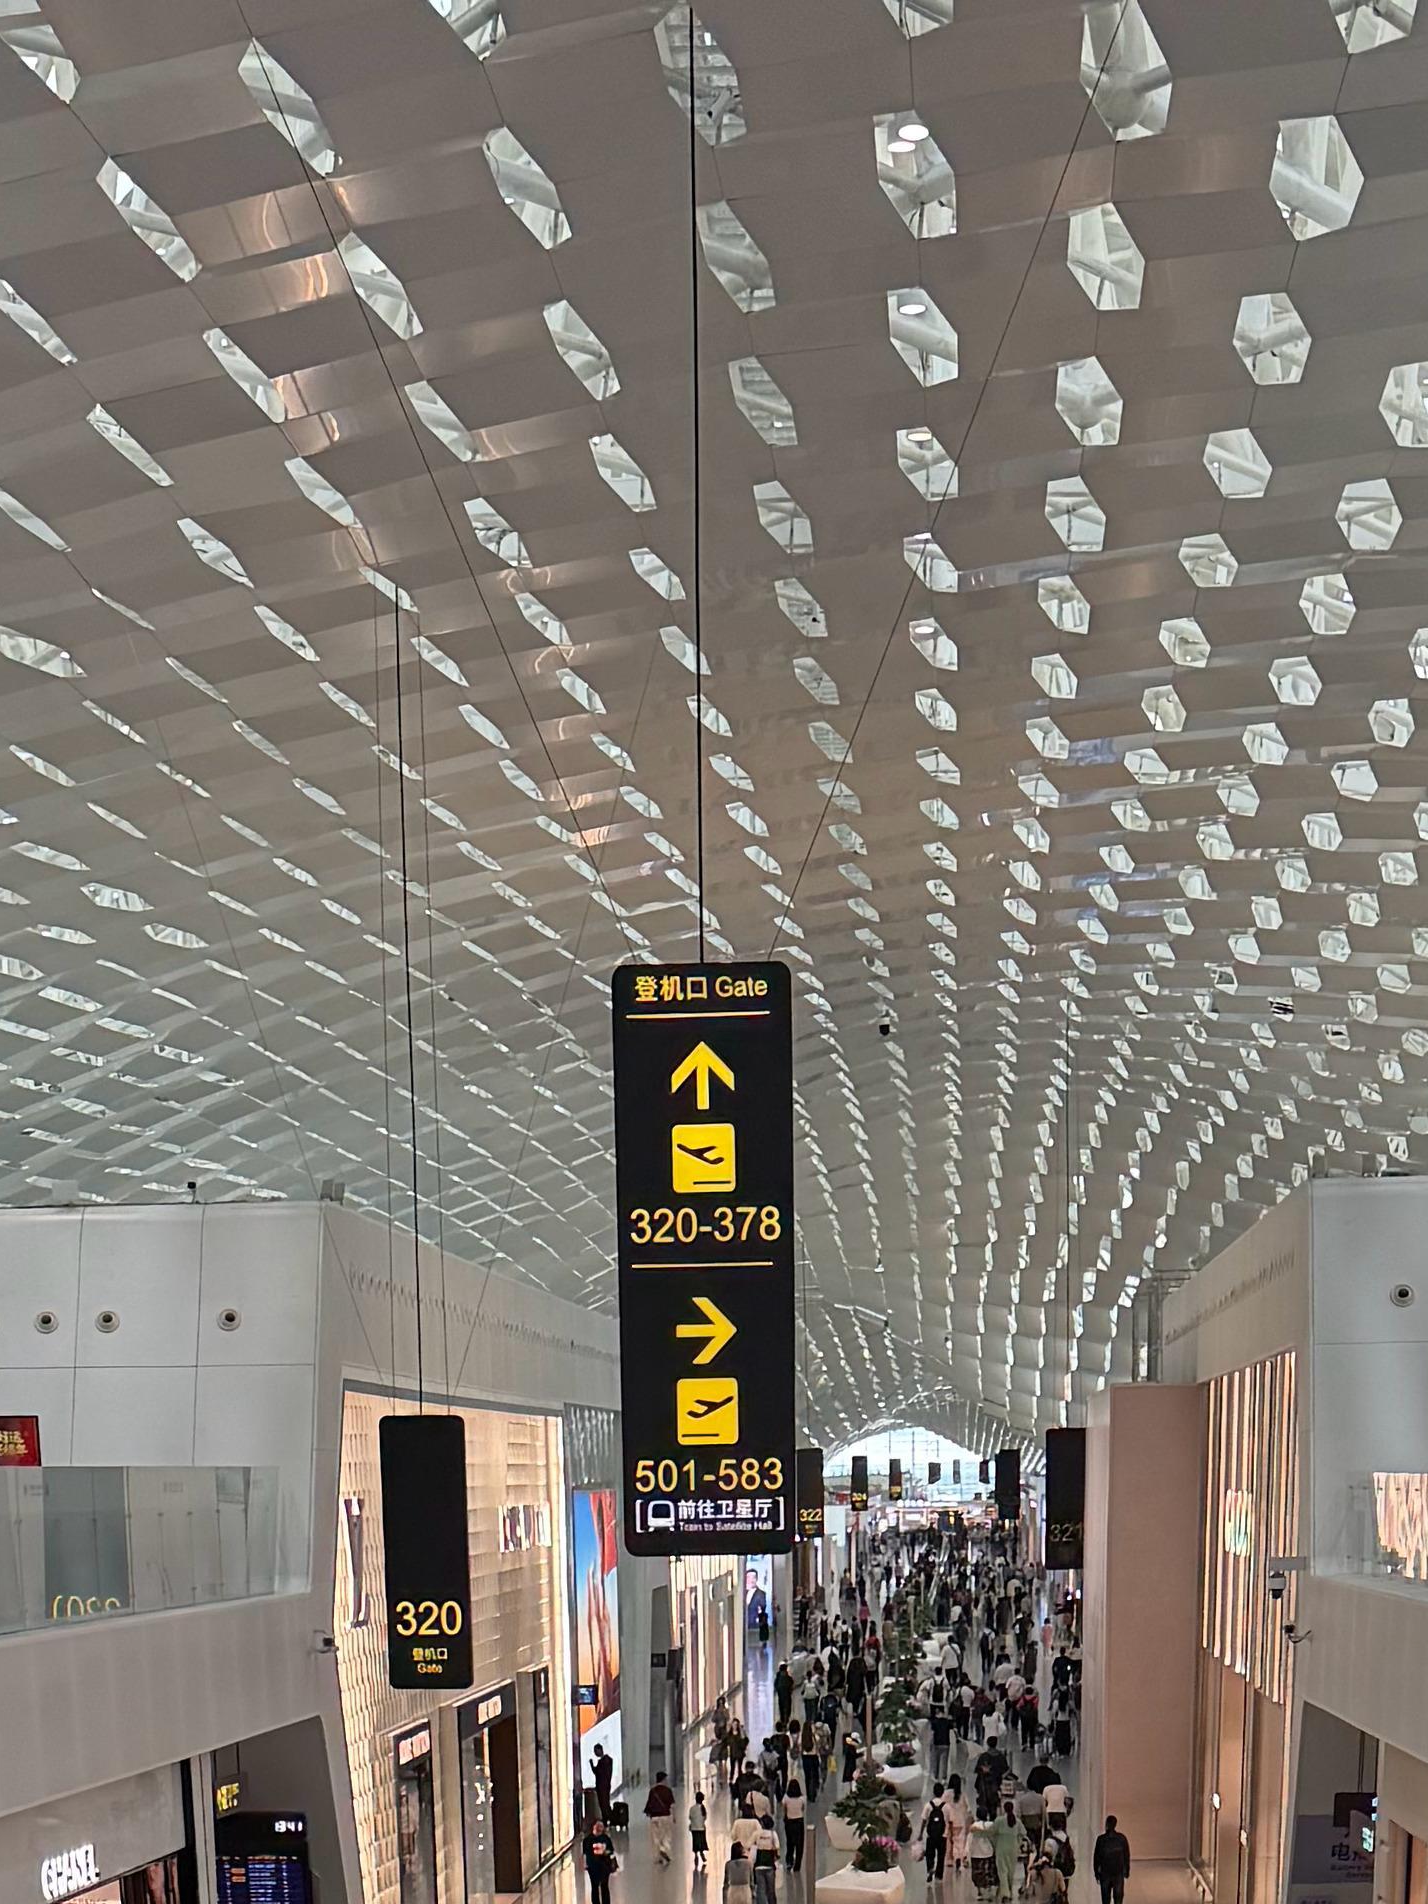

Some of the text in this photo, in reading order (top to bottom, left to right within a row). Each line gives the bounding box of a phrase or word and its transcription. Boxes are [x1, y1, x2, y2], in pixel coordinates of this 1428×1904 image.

[635, 975, 768, 1002] 登机口 Gate
[630, 1205, 781, 1244] 320-378
[635, 1457, 783, 1493] 501-583
[678, 1498, 773, 1519] 前往卫星厅
[396, 1601, 462, 1636] 320
